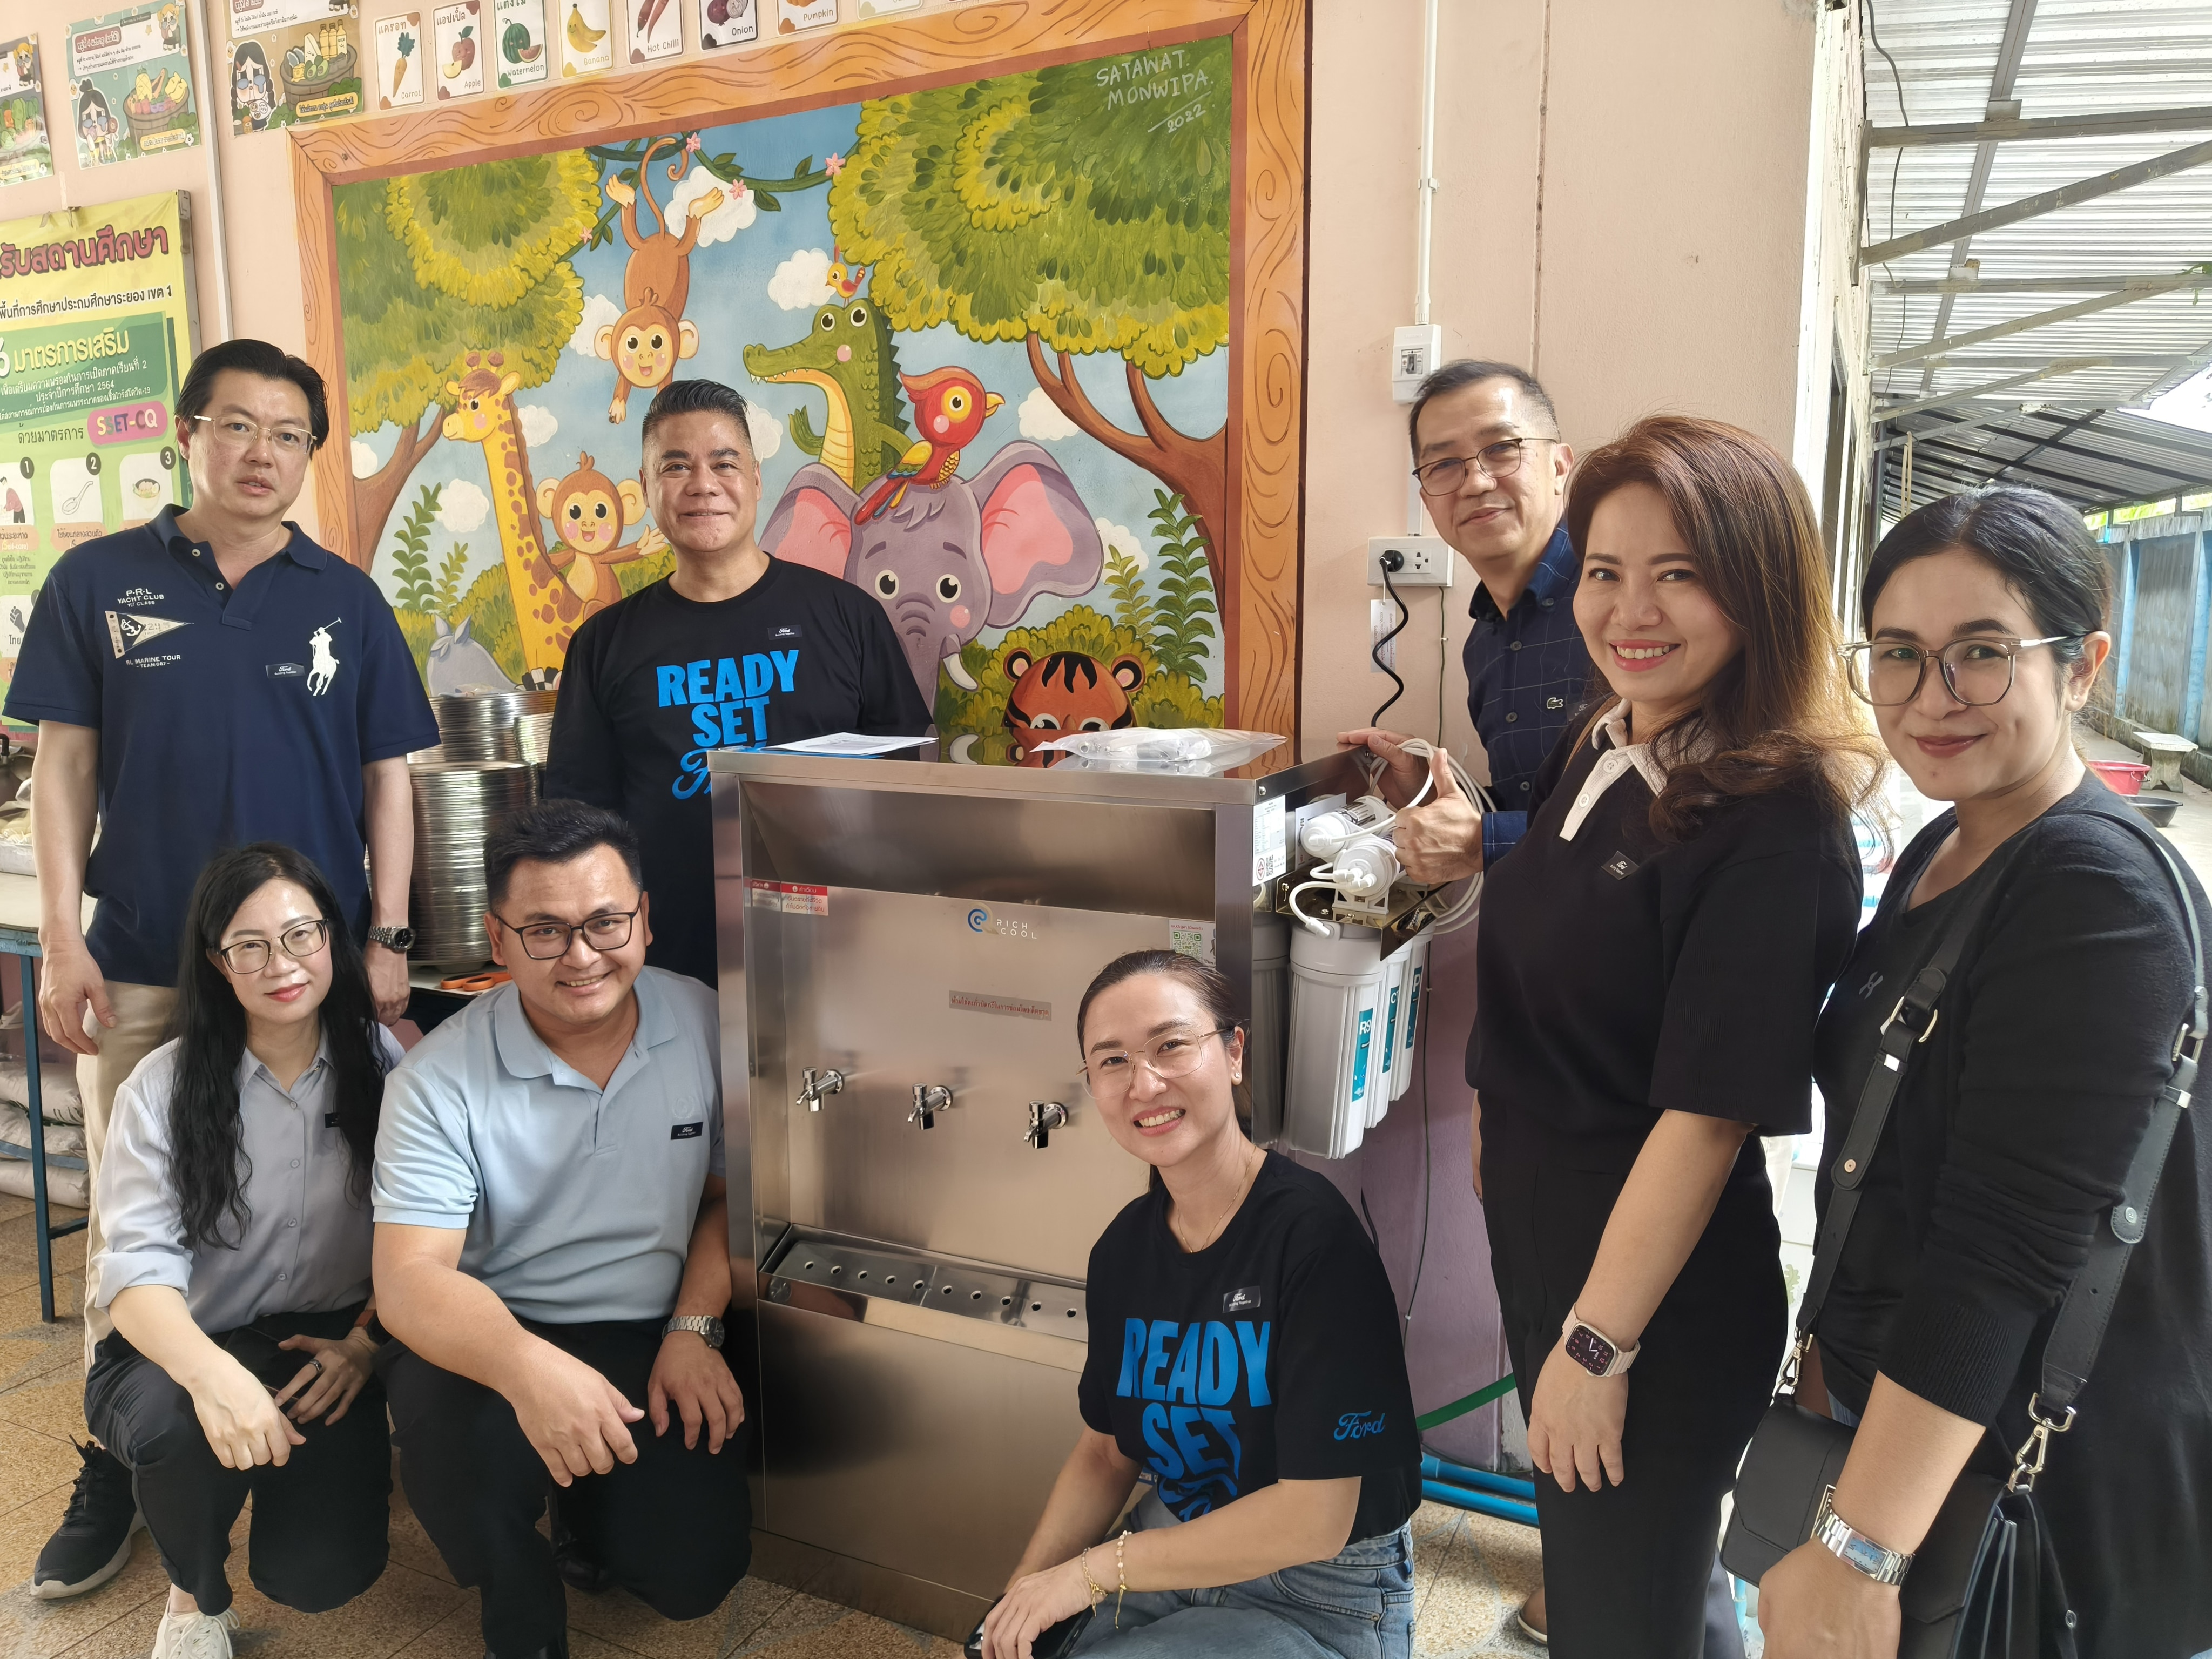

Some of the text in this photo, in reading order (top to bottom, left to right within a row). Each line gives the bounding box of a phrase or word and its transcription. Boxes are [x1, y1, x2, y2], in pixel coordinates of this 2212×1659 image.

[436, 7, 466, 26] แอปเปิ้ล
[804, 9, 833, 22] Pumpkin
[378, 21, 407, 35] แครอท
[732, 26, 753, 36] Onion
[648, 38, 679, 53] Hot Chilli
[583, 55, 610, 66] Banana
[507, 64, 544, 77] Watermelon
[464, 79, 482, 90] Apple
[401, 90, 422, 99] Carrot
[147, 287, 164, 300] เขต
[166, 285, 172, 296] 1
[14, 327, 130, 373] มาตรการเสริม
[143, 360, 147, 369] 2
[36, 380, 115, 402] ประจำปีการศึกษา 2564
[96, 408, 158, 436] SSET-CQ
[18, 422, 84, 444] ด้วยมาตรการ
[90, 456, 97, 470] 2
[165, 451, 172, 464] 3
[24, 461, 29, 474] 1
[117, 596, 141, 604] YACHT
[656, 649, 799, 707] READY
[691, 696, 770, 747] SET
[997, 919, 1027, 929] RICH
[1001, 928, 1037, 939] COOL
[1233, 1293, 1245, 1302] Ford
[1116, 1318, 1272, 1407] READY
[1333, 1411, 1386, 1441] Ford
[1142, 1402, 1241, 1480] SET
